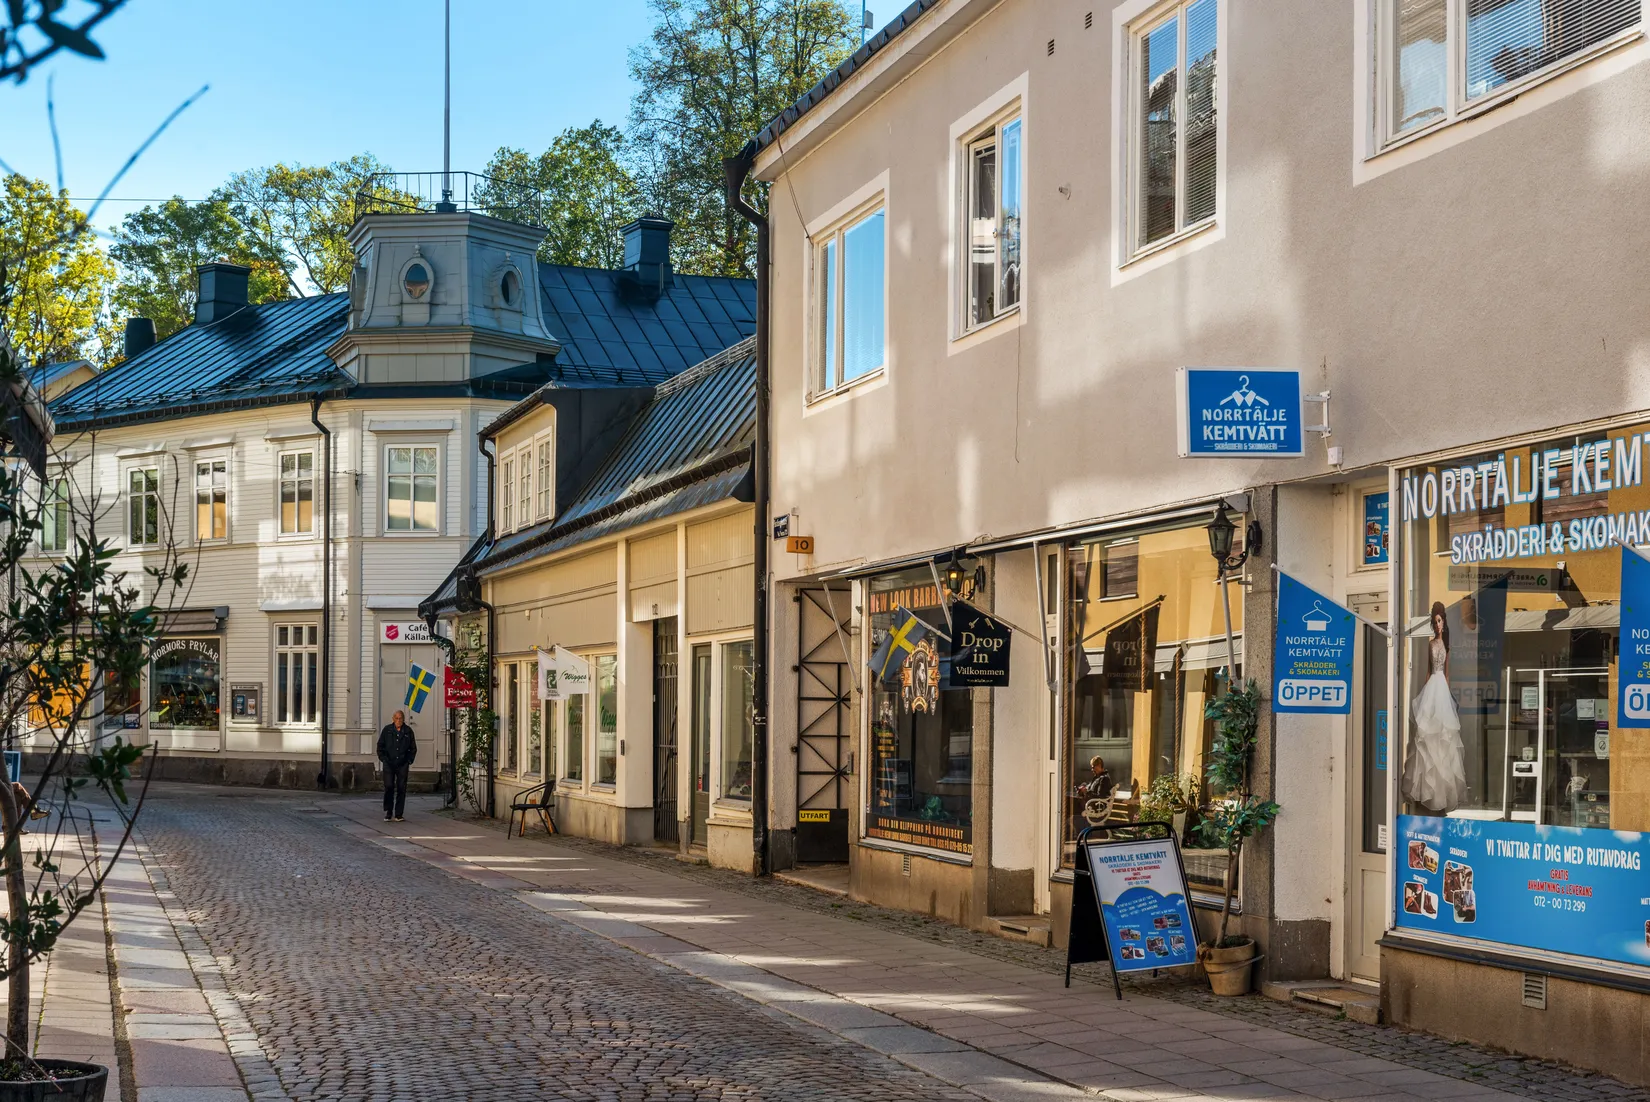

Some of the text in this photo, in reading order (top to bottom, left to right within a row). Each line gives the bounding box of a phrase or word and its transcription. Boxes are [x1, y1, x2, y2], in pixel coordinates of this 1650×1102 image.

[1202, 406, 1287, 421] NORRTÄLJE
[1203, 422, 1287, 440] KEMTVÄTT
[1402, 431, 1650, 522] NORRTÄLJE KEM
[795, 540, 809, 550] 10
[1451, 523, 1546, 565] SKRÄDDERI
[1549, 521, 1565, 554] &
[870, 592, 887, 613] NEW
[890, 589, 910, 610] LOOK
[961, 632, 1003, 651] Drop
[1286, 636, 1346, 646] NORRTÄLJE
[150, 640, 219, 663] MORMORS PRYLAR
[973, 648, 989, 663] in
[1289, 647, 1342, 657] KEMTVÄTT
[956, 666, 1004, 676] Välkommen
[1294, 660, 1336, 669] SKRÄDDERI
[1296, 668, 1340, 676] SKOMAKERI
[564, 672, 586, 681] Wigges
[1637, 670, 1643, 678] &
[1282, 682, 1344, 701] ÖPPET
[900, 820, 924, 833] KLIPPNING
[925, 823, 931, 834] PÅ
[933, 826, 964, 839] BOKADIREKT
[1099, 851, 1167, 864] NORRTÄLJE KEMTVÄTT
[1486, 838, 1641, 870] VI TVÄTTAR ÅT DIG MED RUTAVDRAG
[1550, 869, 1568, 880] GRATIS
[1528, 879, 1560, 894] AVHÄMTNING
[1566, 884, 1592, 897] LEVERANS
[1534, 896, 1545, 907] 072
[1552, 899, 1561, 909] 00
[1564, 900, 1571, 910] 73
[1573, 901, 1586, 912] 299
